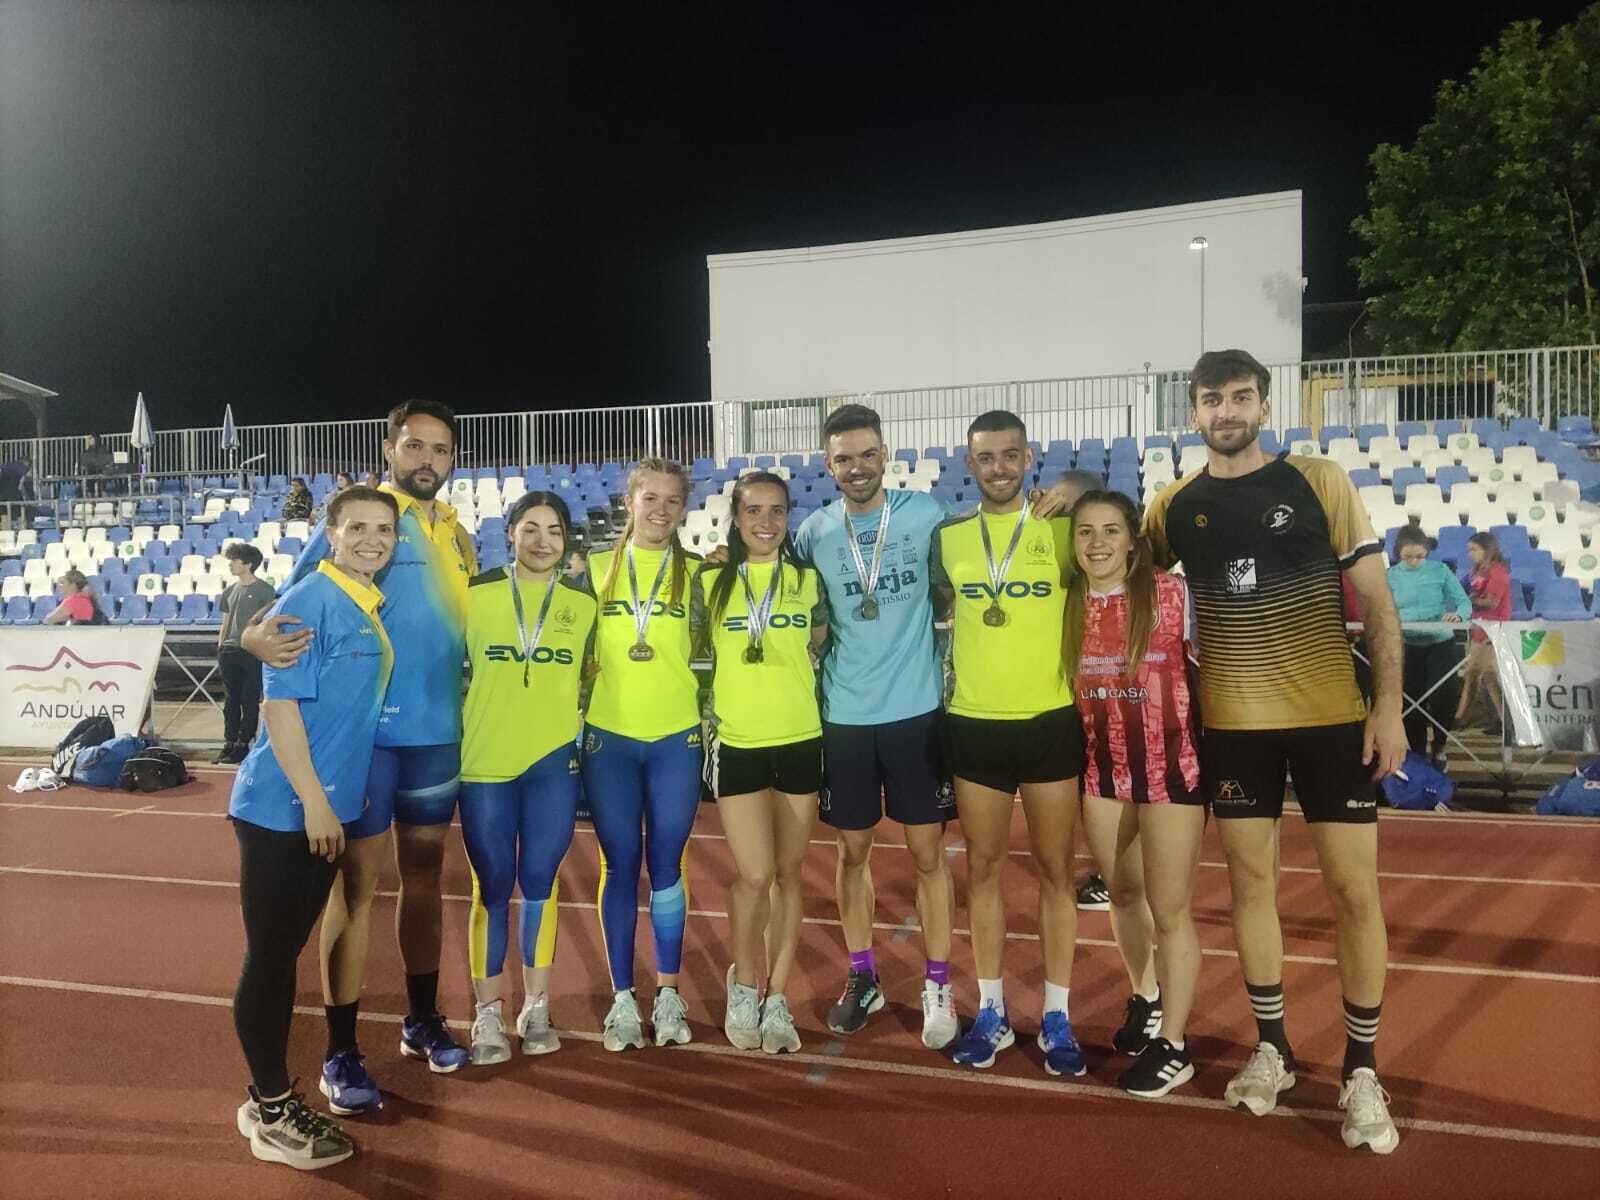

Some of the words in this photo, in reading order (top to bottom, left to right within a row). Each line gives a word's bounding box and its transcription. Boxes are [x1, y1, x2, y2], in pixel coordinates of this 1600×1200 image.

[843, 568, 918, 597] nrja
[960, 580, 1052, 599] EVOS
[723, 613, 808, 632] EOS
[484, 645, 574, 665] EVOS
